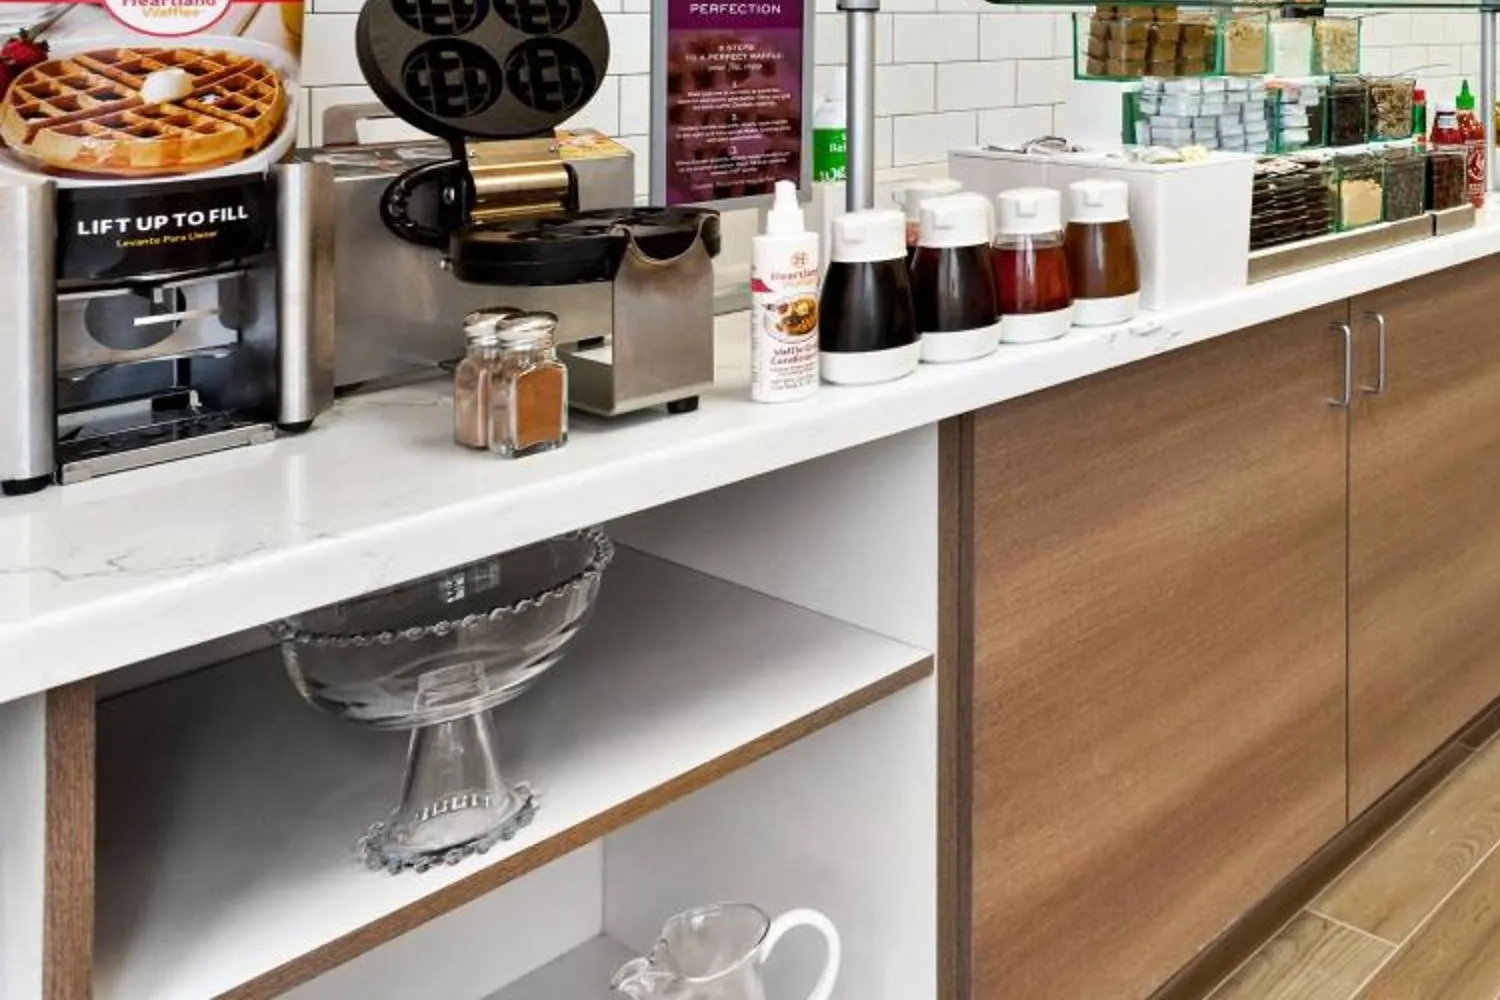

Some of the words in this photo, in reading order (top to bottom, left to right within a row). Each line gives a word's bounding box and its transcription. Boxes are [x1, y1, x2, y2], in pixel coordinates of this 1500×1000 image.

[689, 3, 782, 15] PERFECTION
[708, 52, 748, 61] PERFECT
[77, 217, 132, 235] LIFT
[135, 214, 169, 231] UP
[172, 210, 205, 227] TO
[208, 205, 249, 223] FILL
